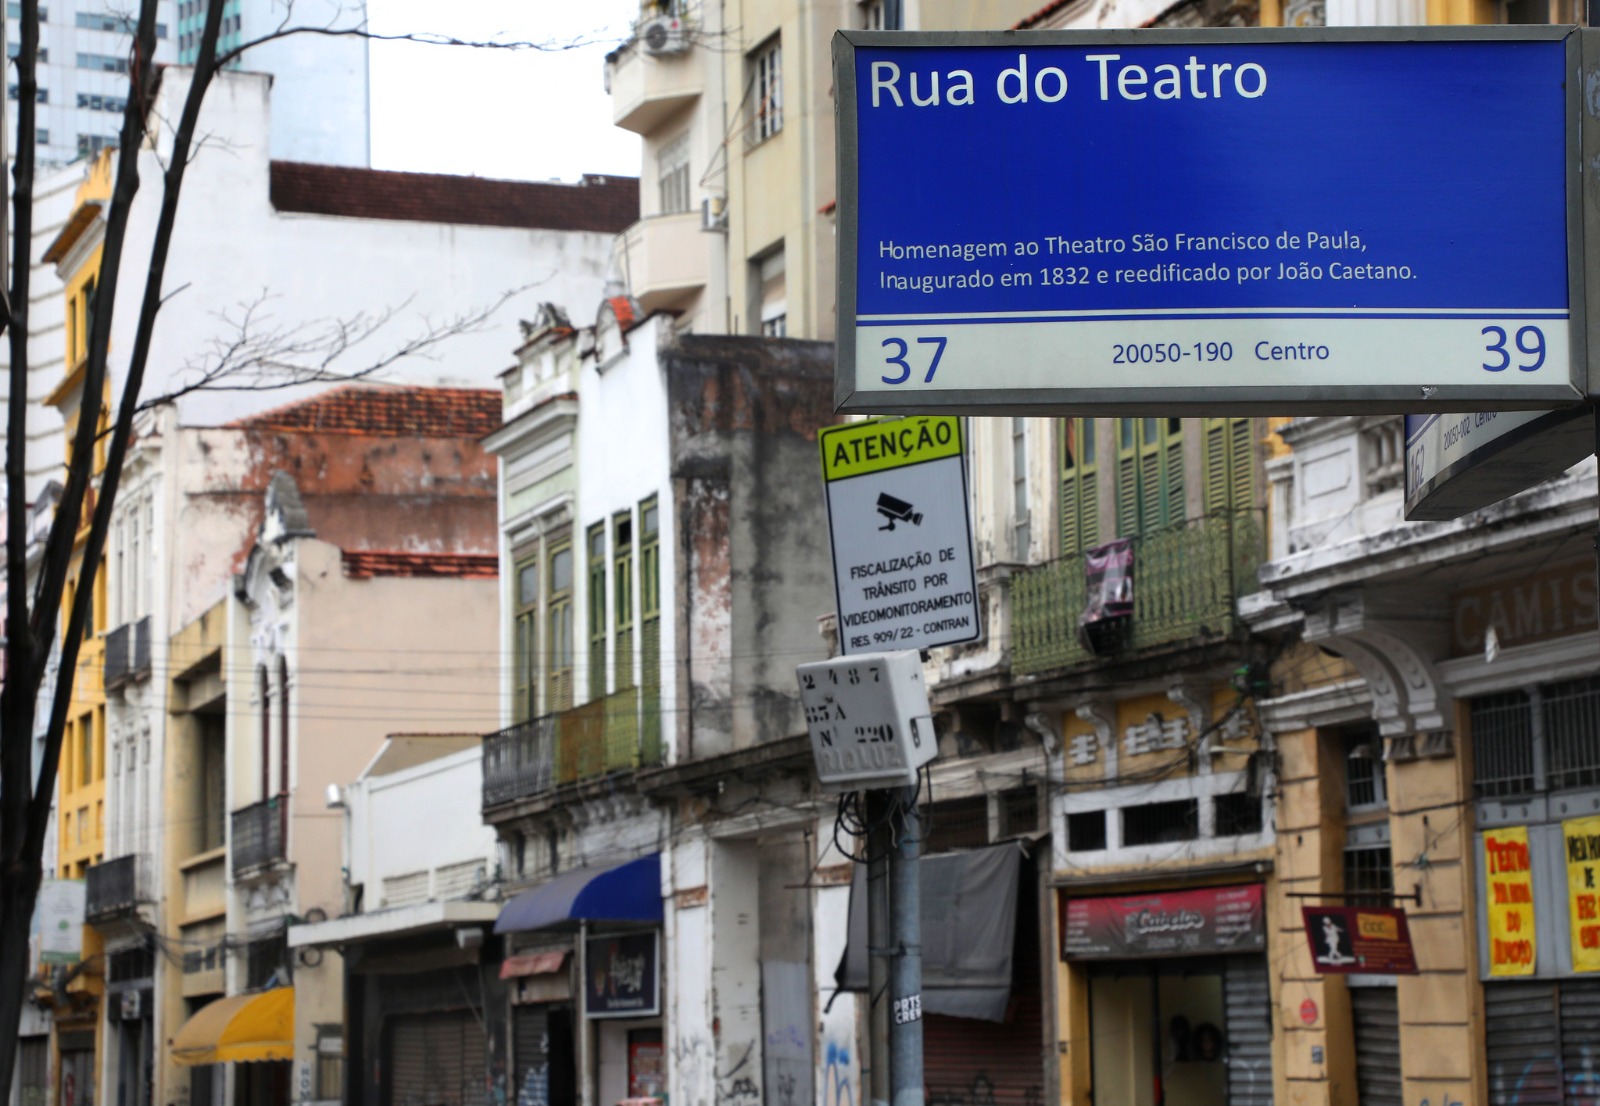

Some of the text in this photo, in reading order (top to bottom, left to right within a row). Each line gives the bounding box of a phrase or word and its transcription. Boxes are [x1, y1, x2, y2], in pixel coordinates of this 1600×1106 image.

[872, 54, 1268, 107] Rua do Teatro
[880, 230, 1367, 262] Homenagem ao Theatro São Francisco de Paula,
[880, 260, 1417, 293] Inaugurado em 1832 e reedificado por João Caetano.
[881, 337, 948, 384] 37
[1112, 341, 1330, 364] 20050-190 Centro
[1481, 325, 1546, 373] 39
[833, 418, 951, 467] ATENÇÃO
[1411, 444, 1424, 494] 162
[850, 547, 955, 579] FISCALIZAÇÃO DE
[863, 572, 948, 600] TRÂNSITO POR
[843, 592, 973, 627] VIDEOMONITORAMENTO
[923, 616, 970, 635] CONTRAN
